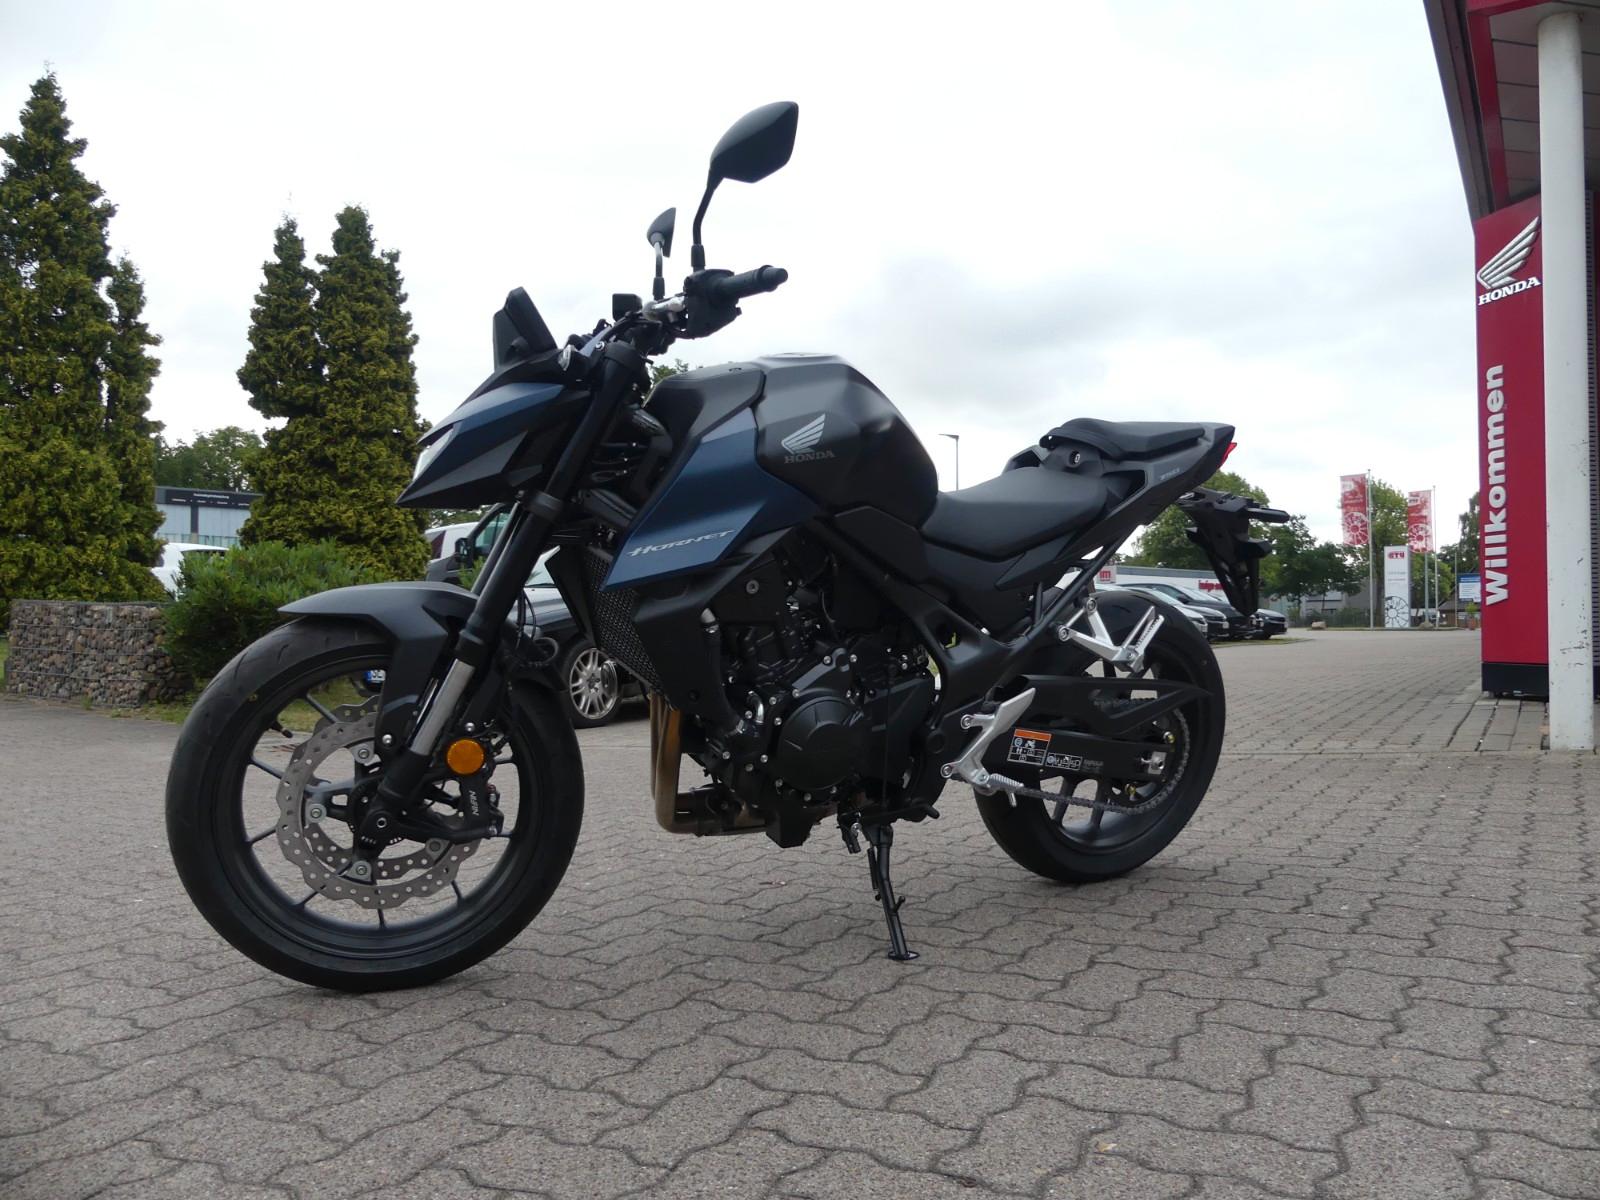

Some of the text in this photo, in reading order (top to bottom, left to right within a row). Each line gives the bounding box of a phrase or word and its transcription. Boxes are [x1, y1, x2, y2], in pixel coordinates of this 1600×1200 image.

[1477, 276, 1541, 305] HONDA
[783, 450, 836, 464] HONDA
[1485, 364, 1509, 606] Willkommen
